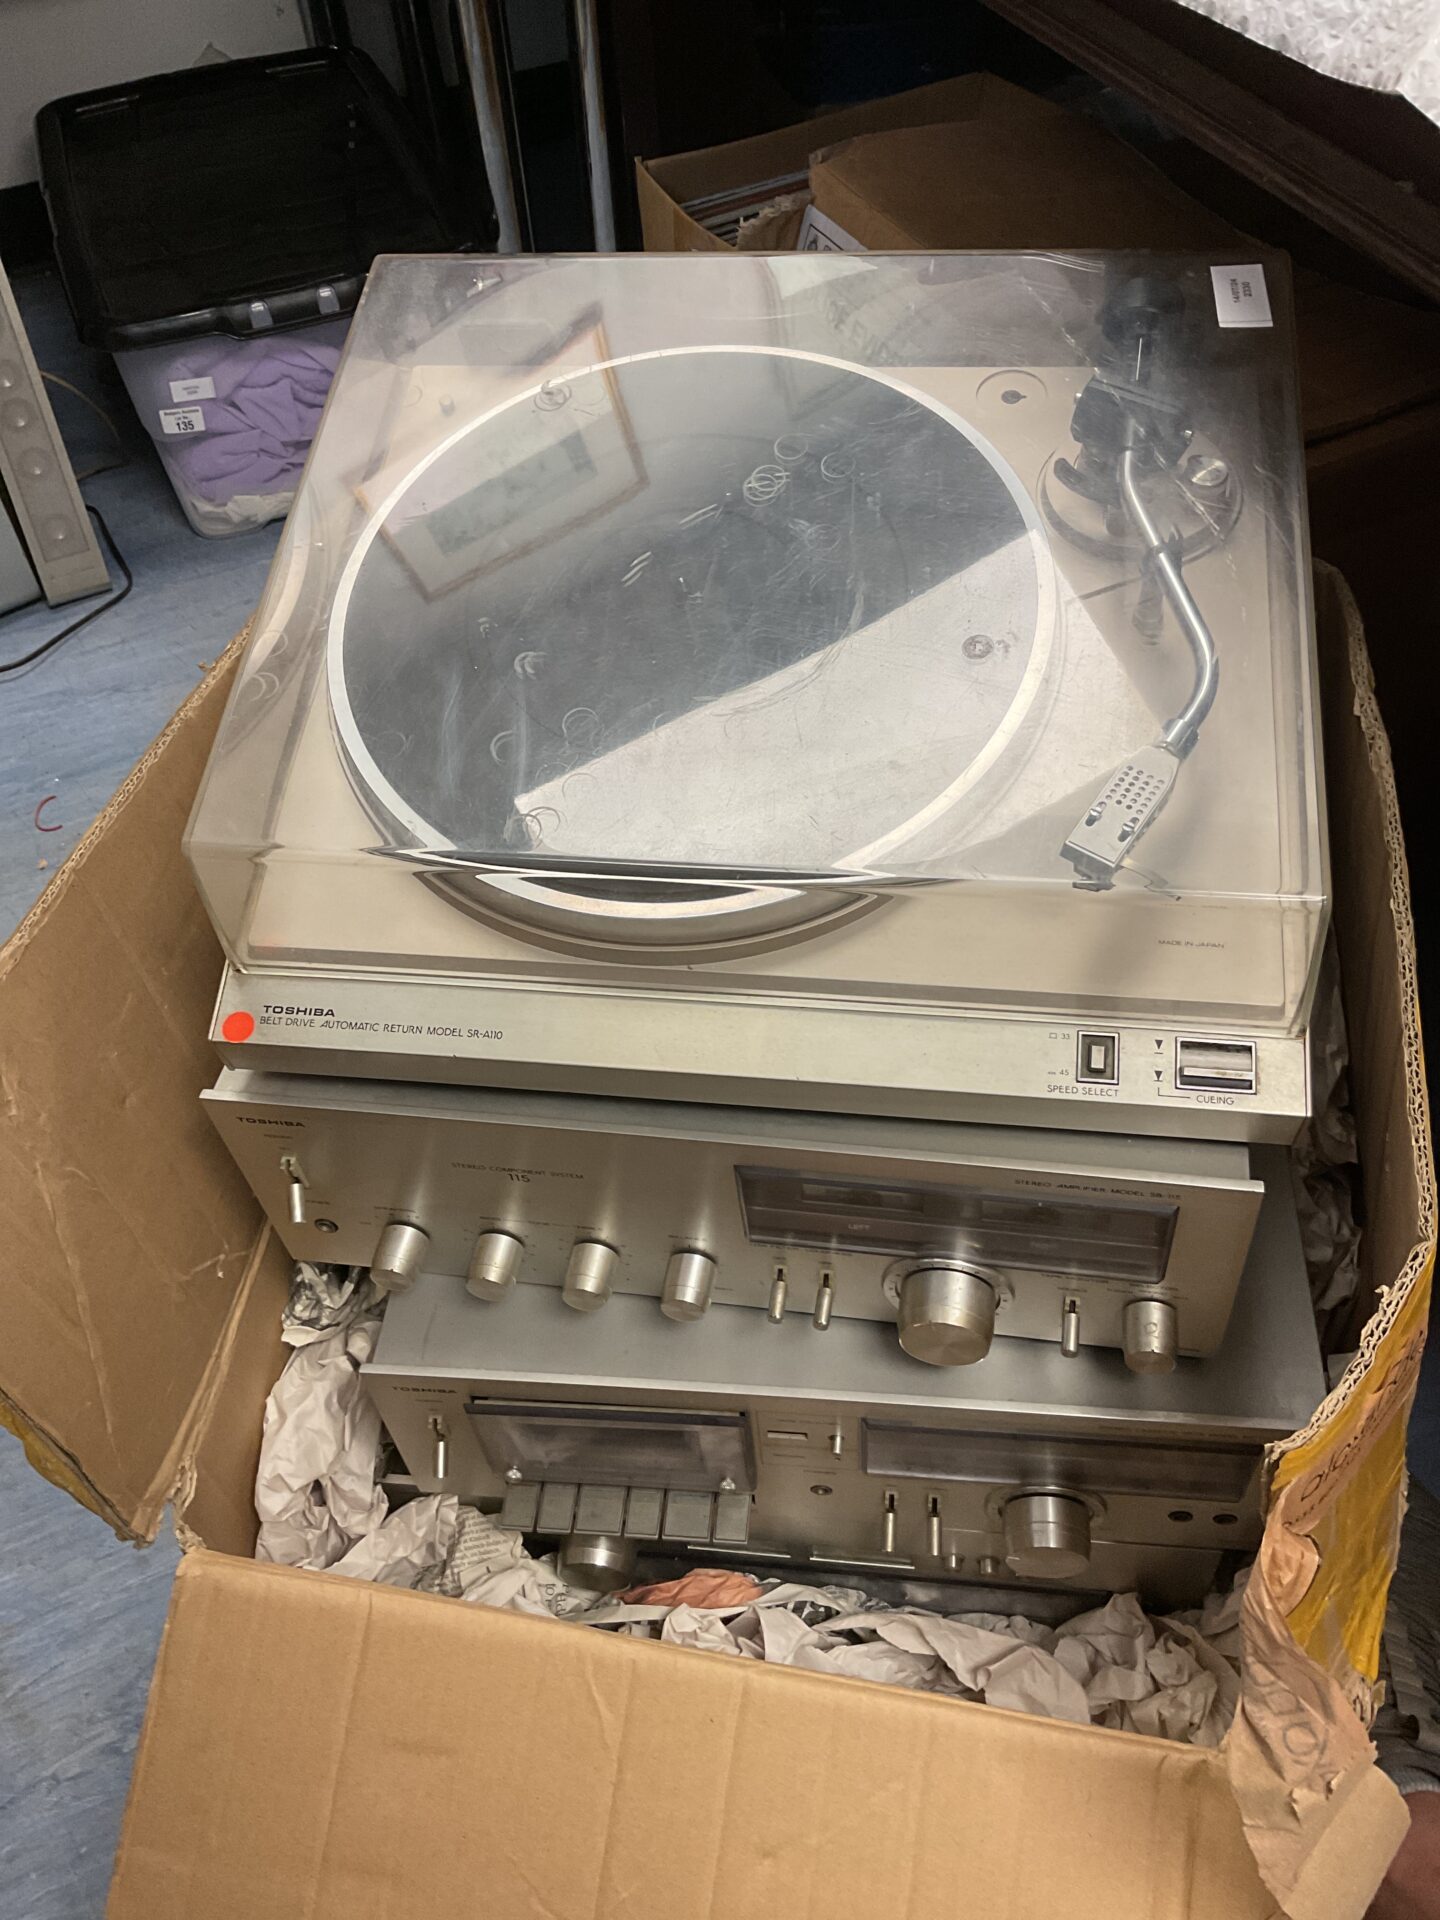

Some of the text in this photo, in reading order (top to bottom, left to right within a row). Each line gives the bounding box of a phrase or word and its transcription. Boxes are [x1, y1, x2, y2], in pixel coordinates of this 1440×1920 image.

[176, 420, 195, 432] 135
[1195, 941, 1225, 949] JAPAN
[263, 1004, 336, 1018] TOSHIBA
[259, 1015, 504, 1040] BELT DRIVE AUTOMATIC RETURN MODEL SR-A110
[1047, 1084, 1119, 1097] SPEED SELECT
[1196, 1094, 1235, 1106] CUEING
[236, 1116, 306, 1128] TOSHIBA
[451, 1162, 584, 1180] STEREO COMPONENT SYSTEM
[507, 1173, 531, 1183] 115
[1014, 1178, 1052, 1188] STEREO
[1056, 1183, 1106, 1193] AMPLIFIER
[1110, 1187, 1145, 1197] MODEL
[391, 1385, 458, 1394] TOSHIBA
